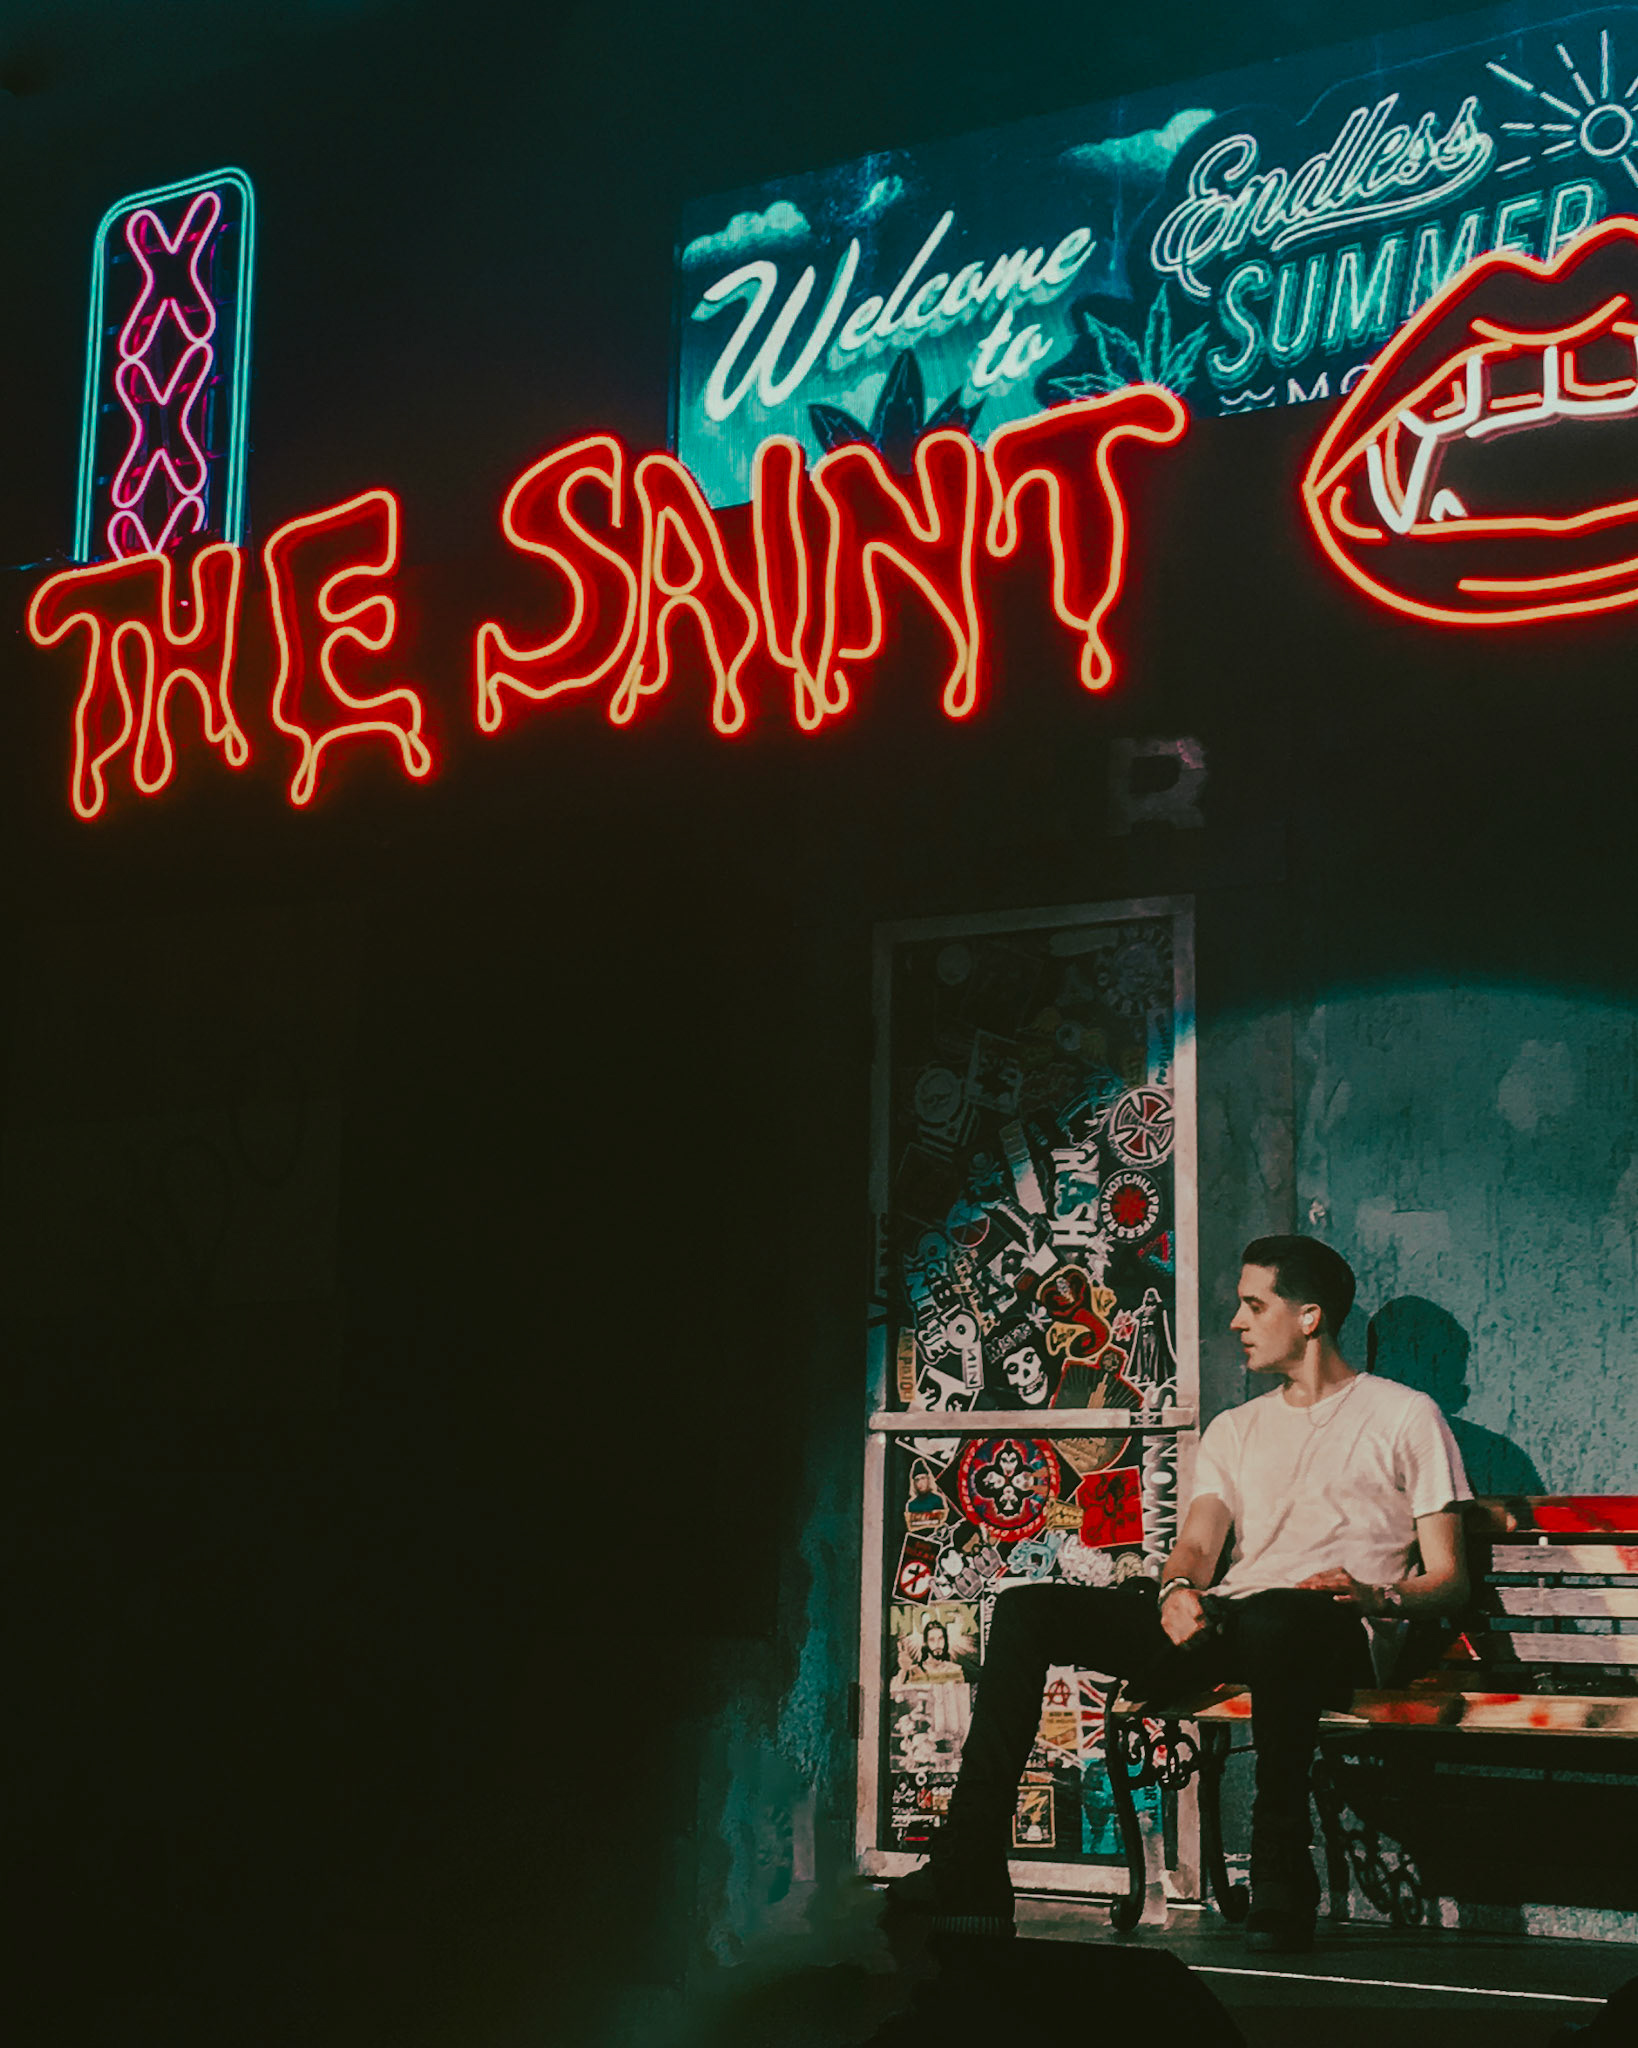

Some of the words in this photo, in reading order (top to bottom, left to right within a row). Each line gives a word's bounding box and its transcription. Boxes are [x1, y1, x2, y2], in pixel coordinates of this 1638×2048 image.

[1151, 93, 1494, 298] Endless
[694, 210, 1098, 422] Welcome
[969, 312, 1055, 390] to
[27, 488, 432, 820] THE
[475, 382, 1189, 737] SAINT
[1101, 1202, 1118, 1231] RED
[1102, 1175, 1123, 1201] HOT
[890, 1603, 980, 1636] NOFX
